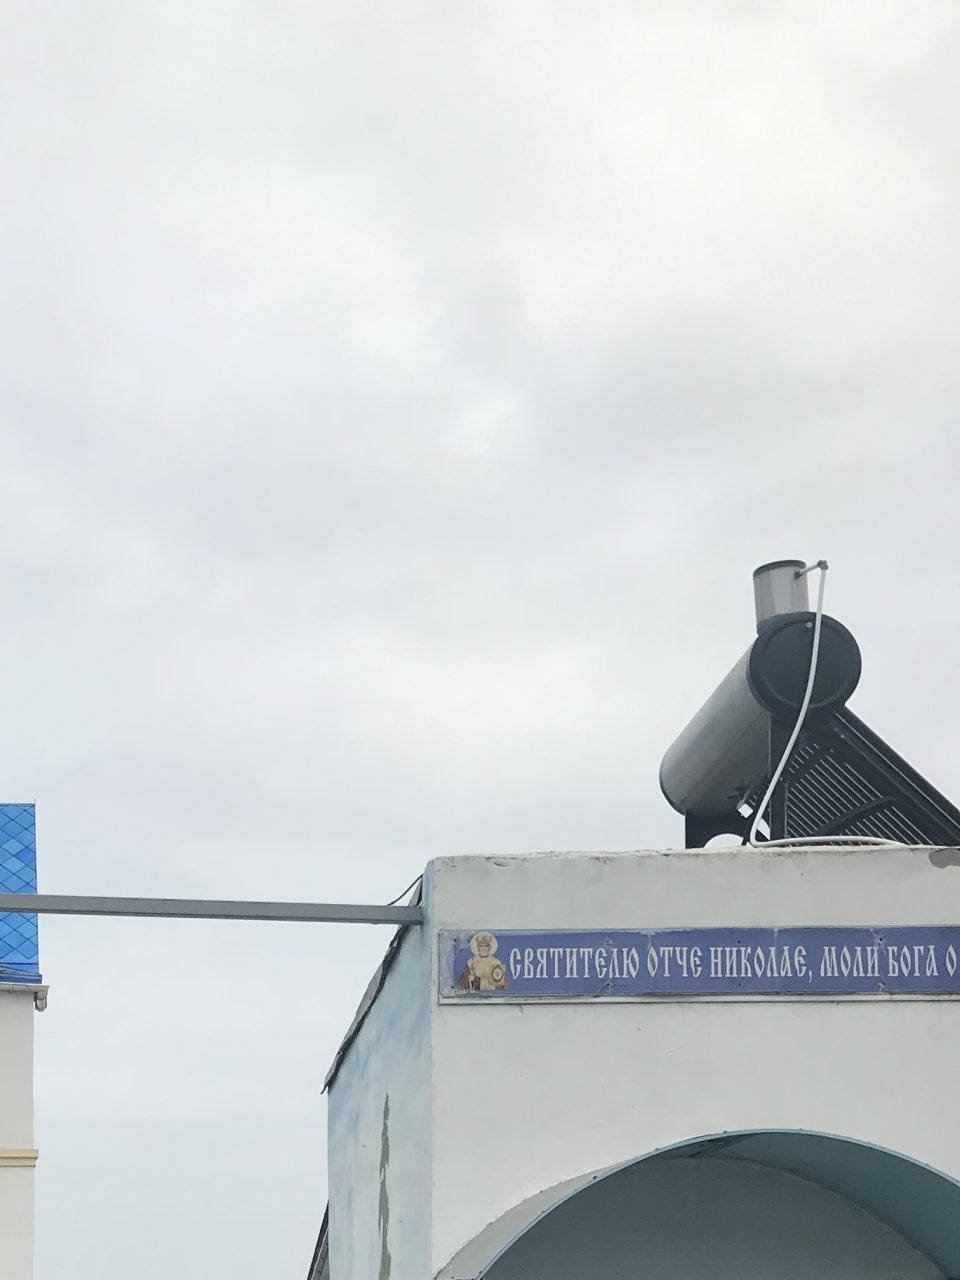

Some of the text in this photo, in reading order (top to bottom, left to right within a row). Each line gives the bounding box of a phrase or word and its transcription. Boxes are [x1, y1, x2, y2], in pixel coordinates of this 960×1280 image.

[509, 944, 957, 984] СВЯТИТЕЛЮ ОТЧЕ НИКОЛАЕ, МОЛИ БОГА О
